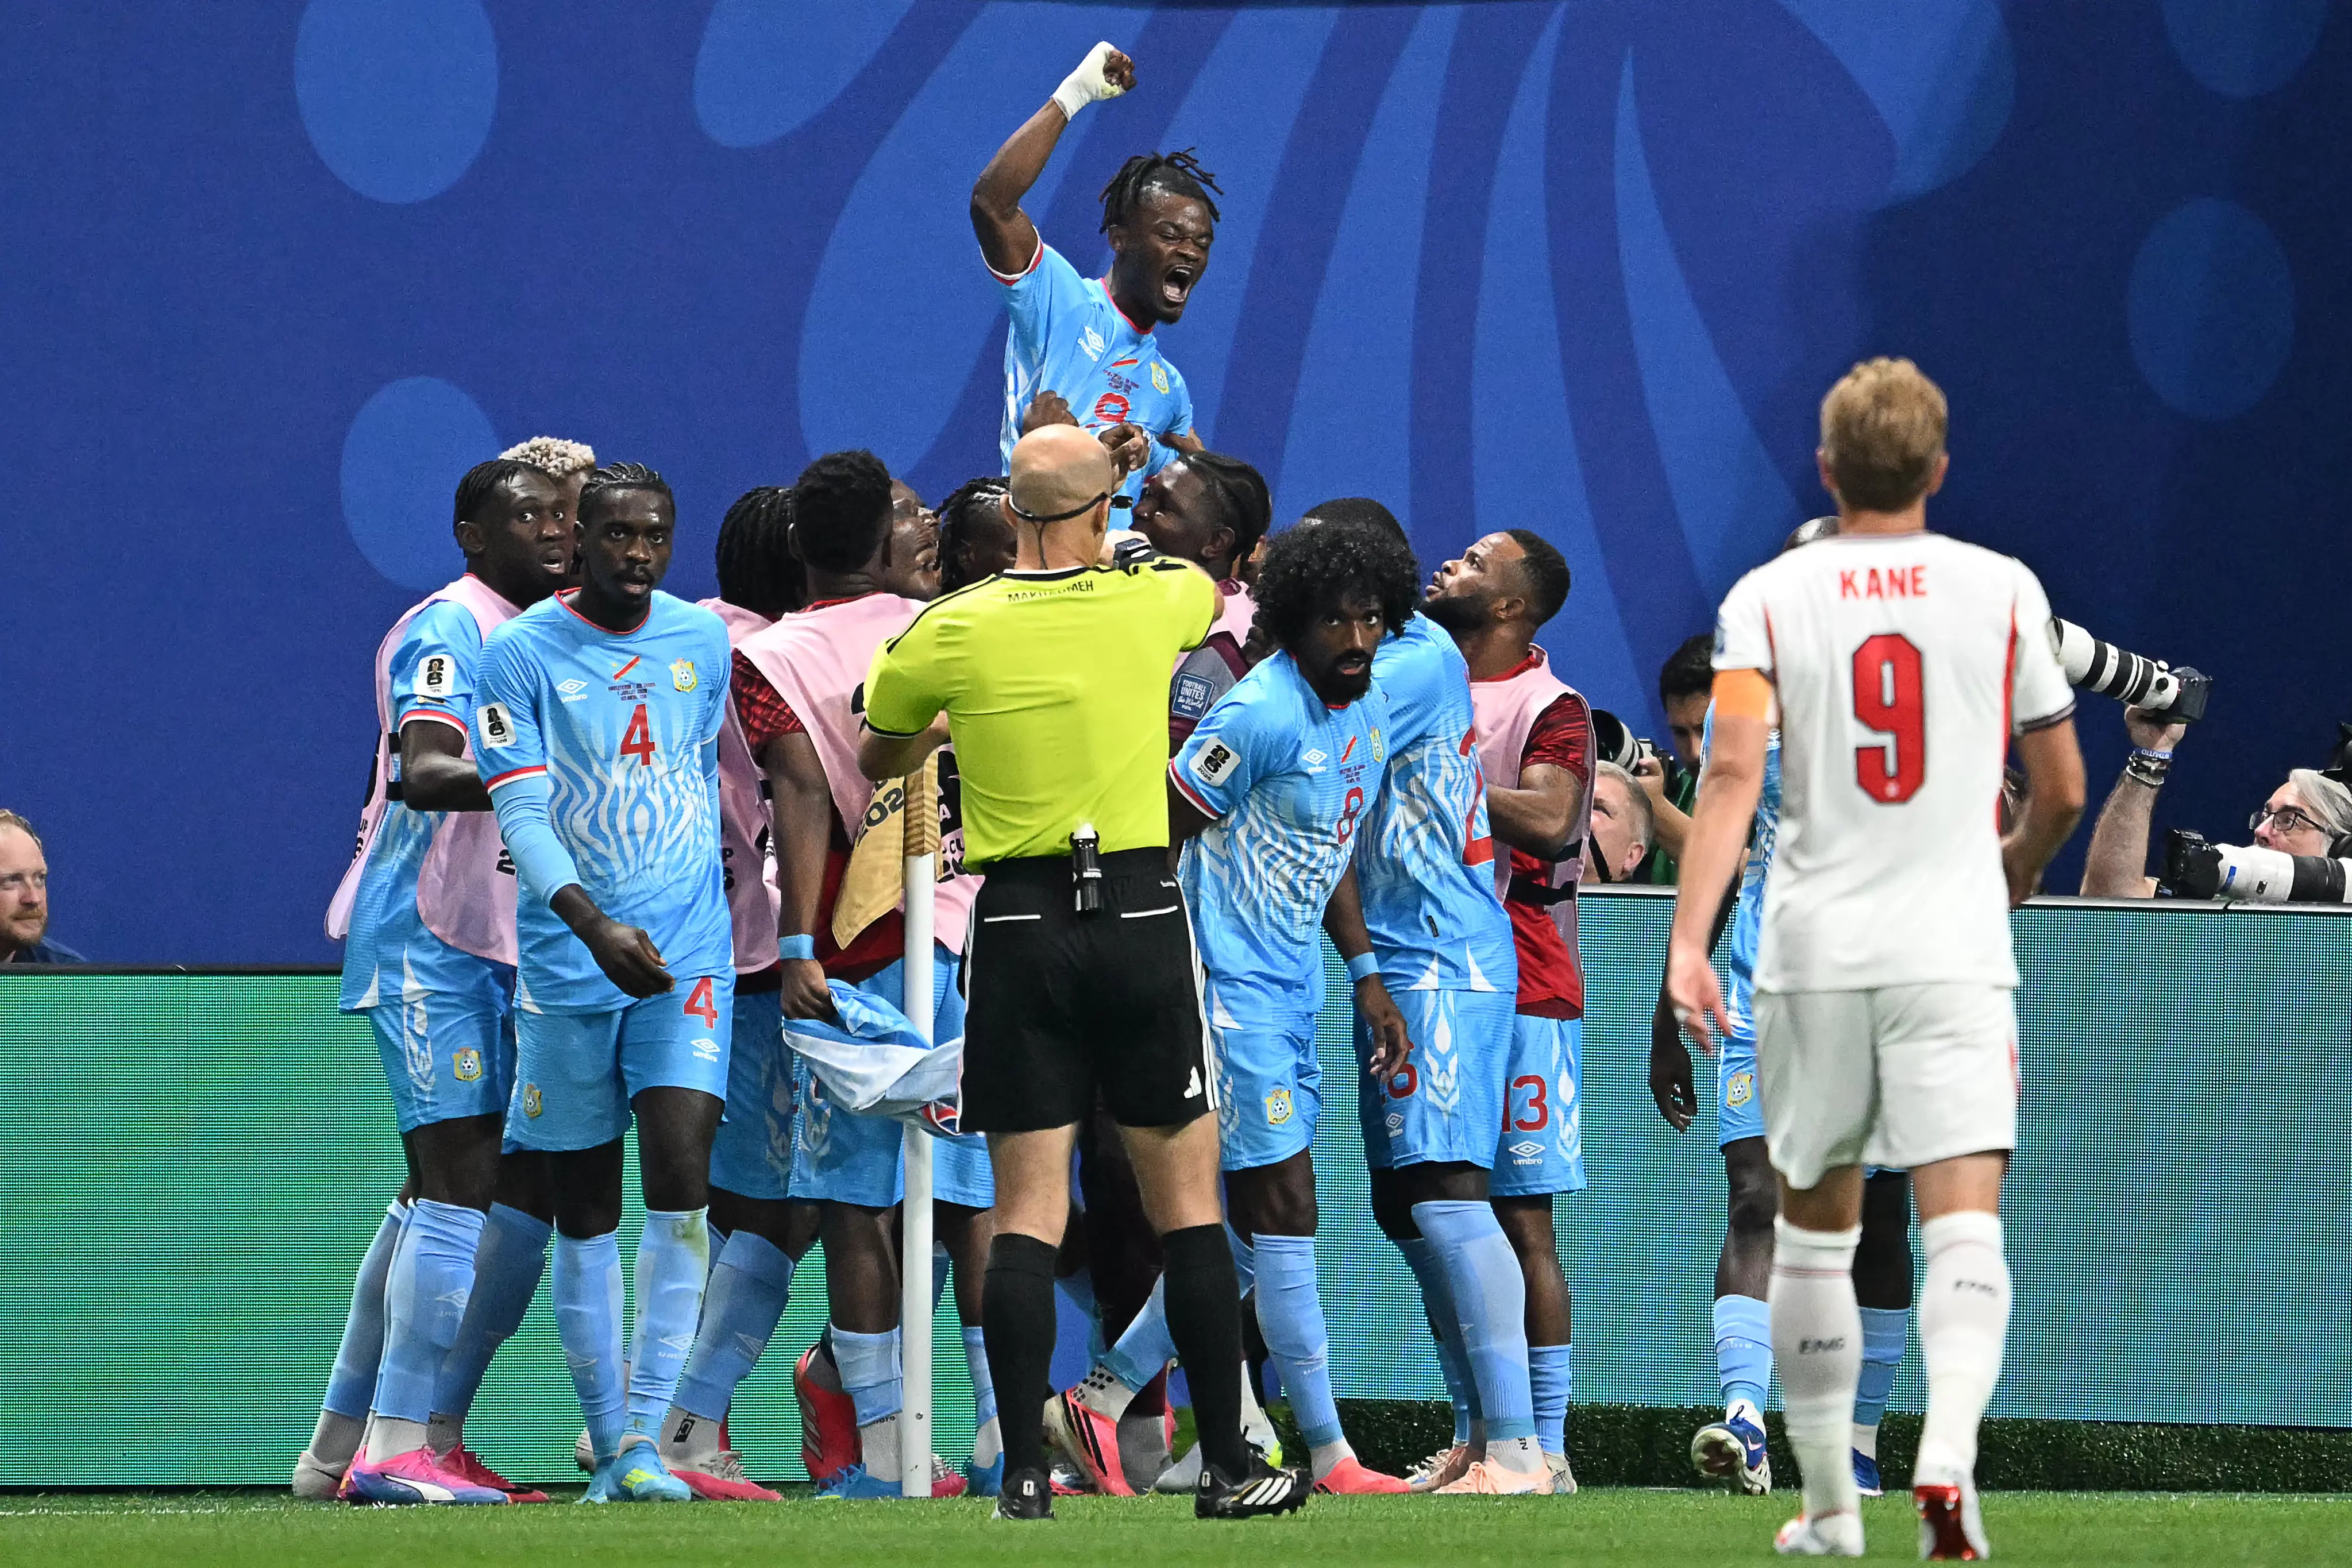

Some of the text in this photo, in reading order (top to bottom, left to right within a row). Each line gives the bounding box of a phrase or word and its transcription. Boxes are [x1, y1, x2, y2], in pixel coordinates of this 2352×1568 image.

[1077, 337, 1098, 362] umbro
[1840, 565, 1927, 599] KANE
[561, 693, 587, 703] umbro
[1180, 686, 1205, 701] UNITES
[1182, 679, 1206, 693] FOOTBALL
[1185, 697, 1204, 709] World
[1852, 633, 1925, 805] 9
[620, 703, 656, 766] 4
[1197, 767, 1212, 781] 2026
[1336, 786, 1364, 845] 8
[683, 976, 719, 1029] 4
[693, 1051, 718, 1063] umbro
[1501, 1075, 1549, 1134] 13
